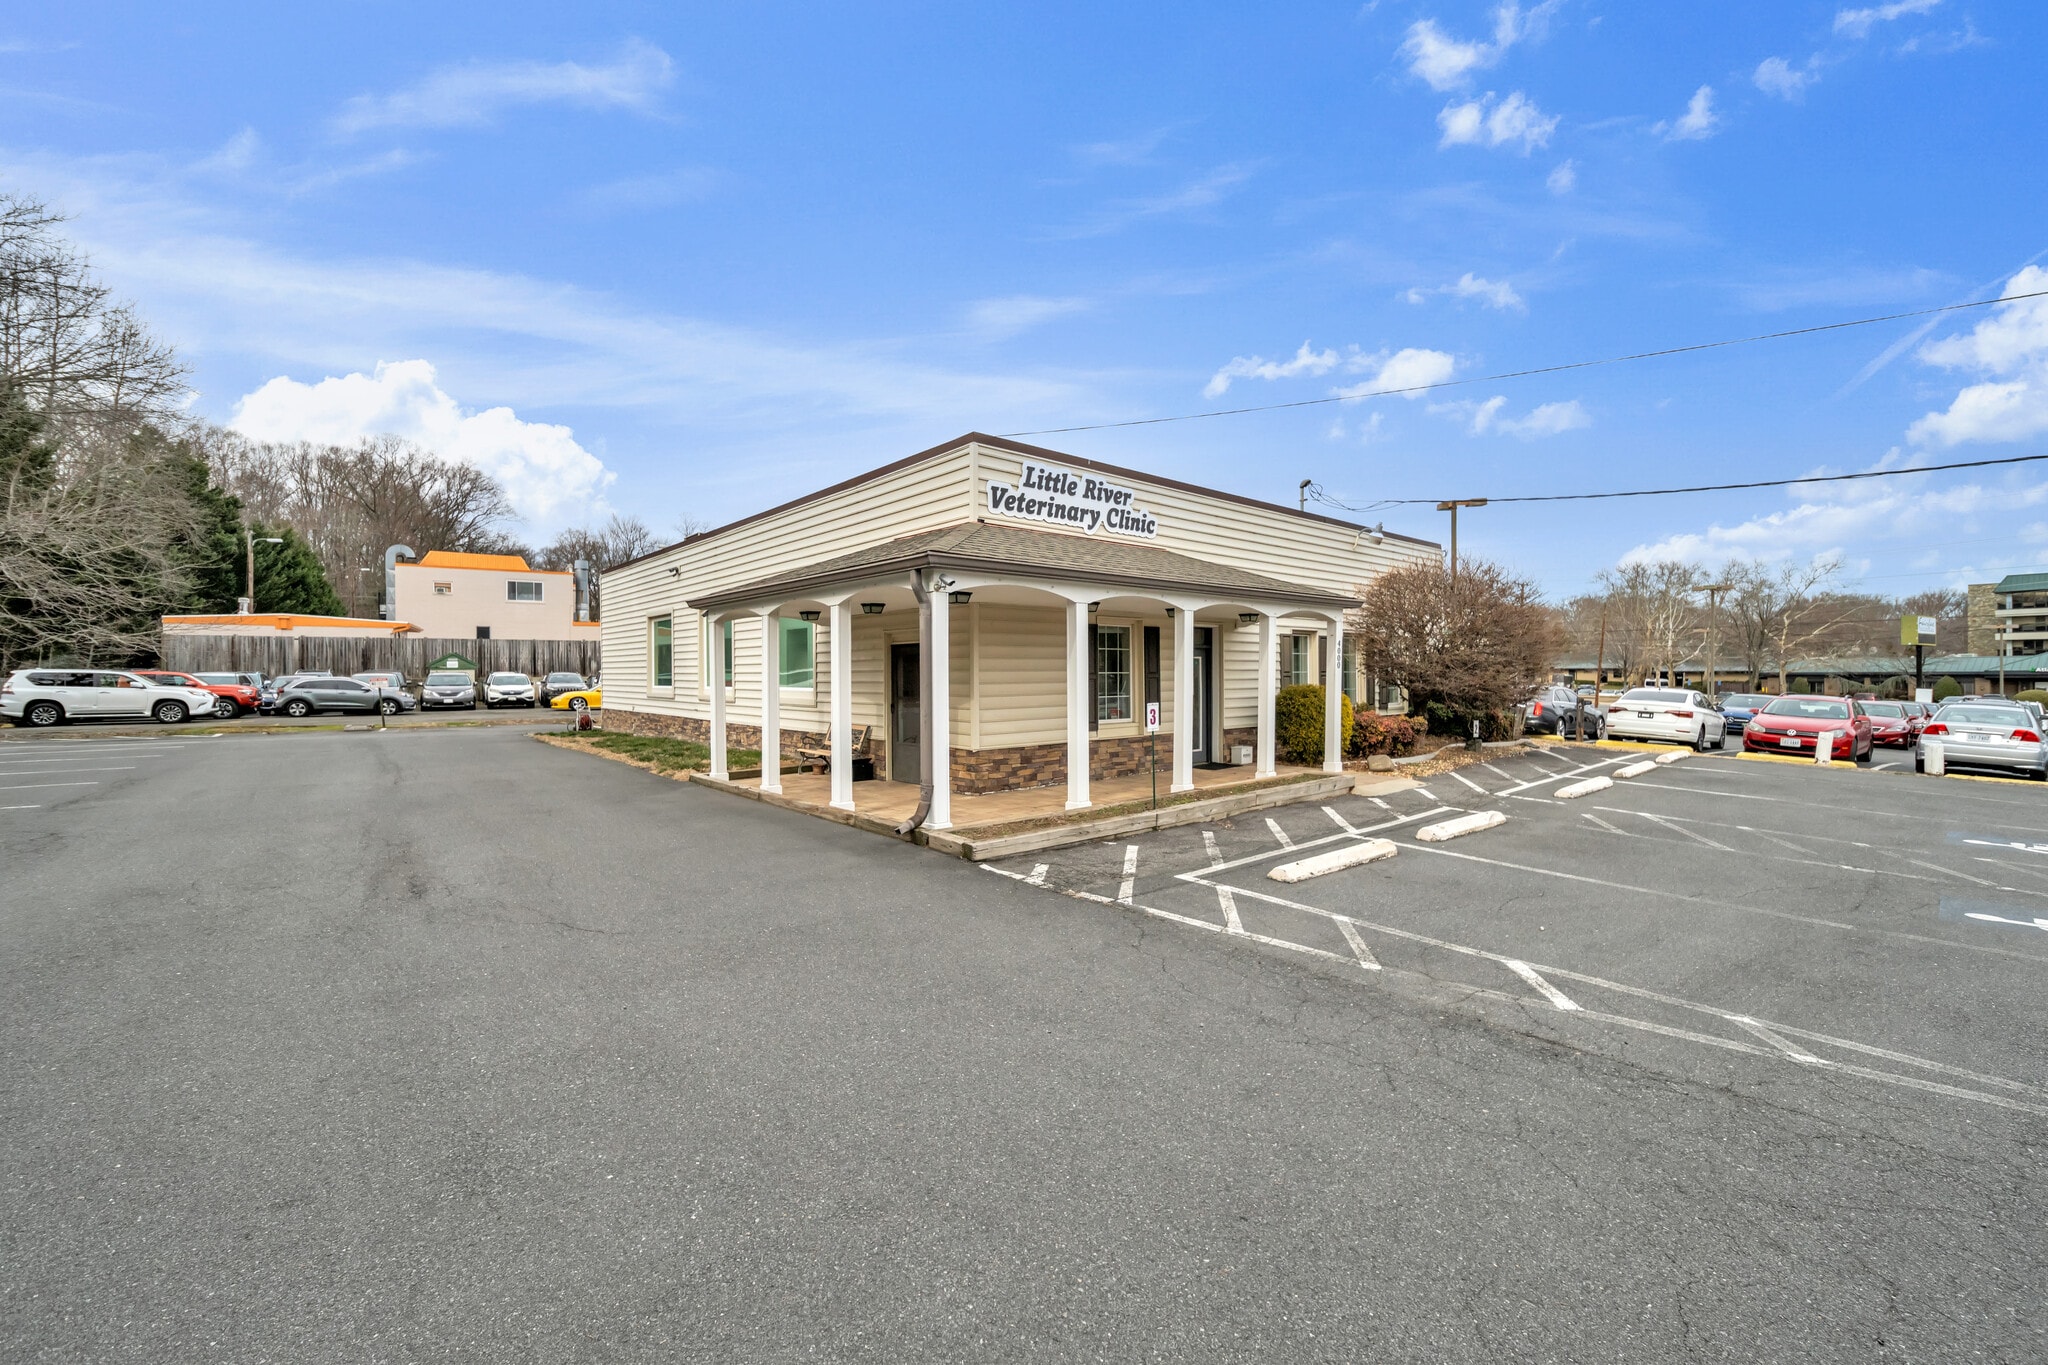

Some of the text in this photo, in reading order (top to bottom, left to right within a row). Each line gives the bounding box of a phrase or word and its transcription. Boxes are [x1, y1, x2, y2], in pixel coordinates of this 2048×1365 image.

[1023, 466, 1132, 507] Little River
[990, 485, 1156, 534] Veterinary Clinic
[1149, 708, 1157, 726] 3
